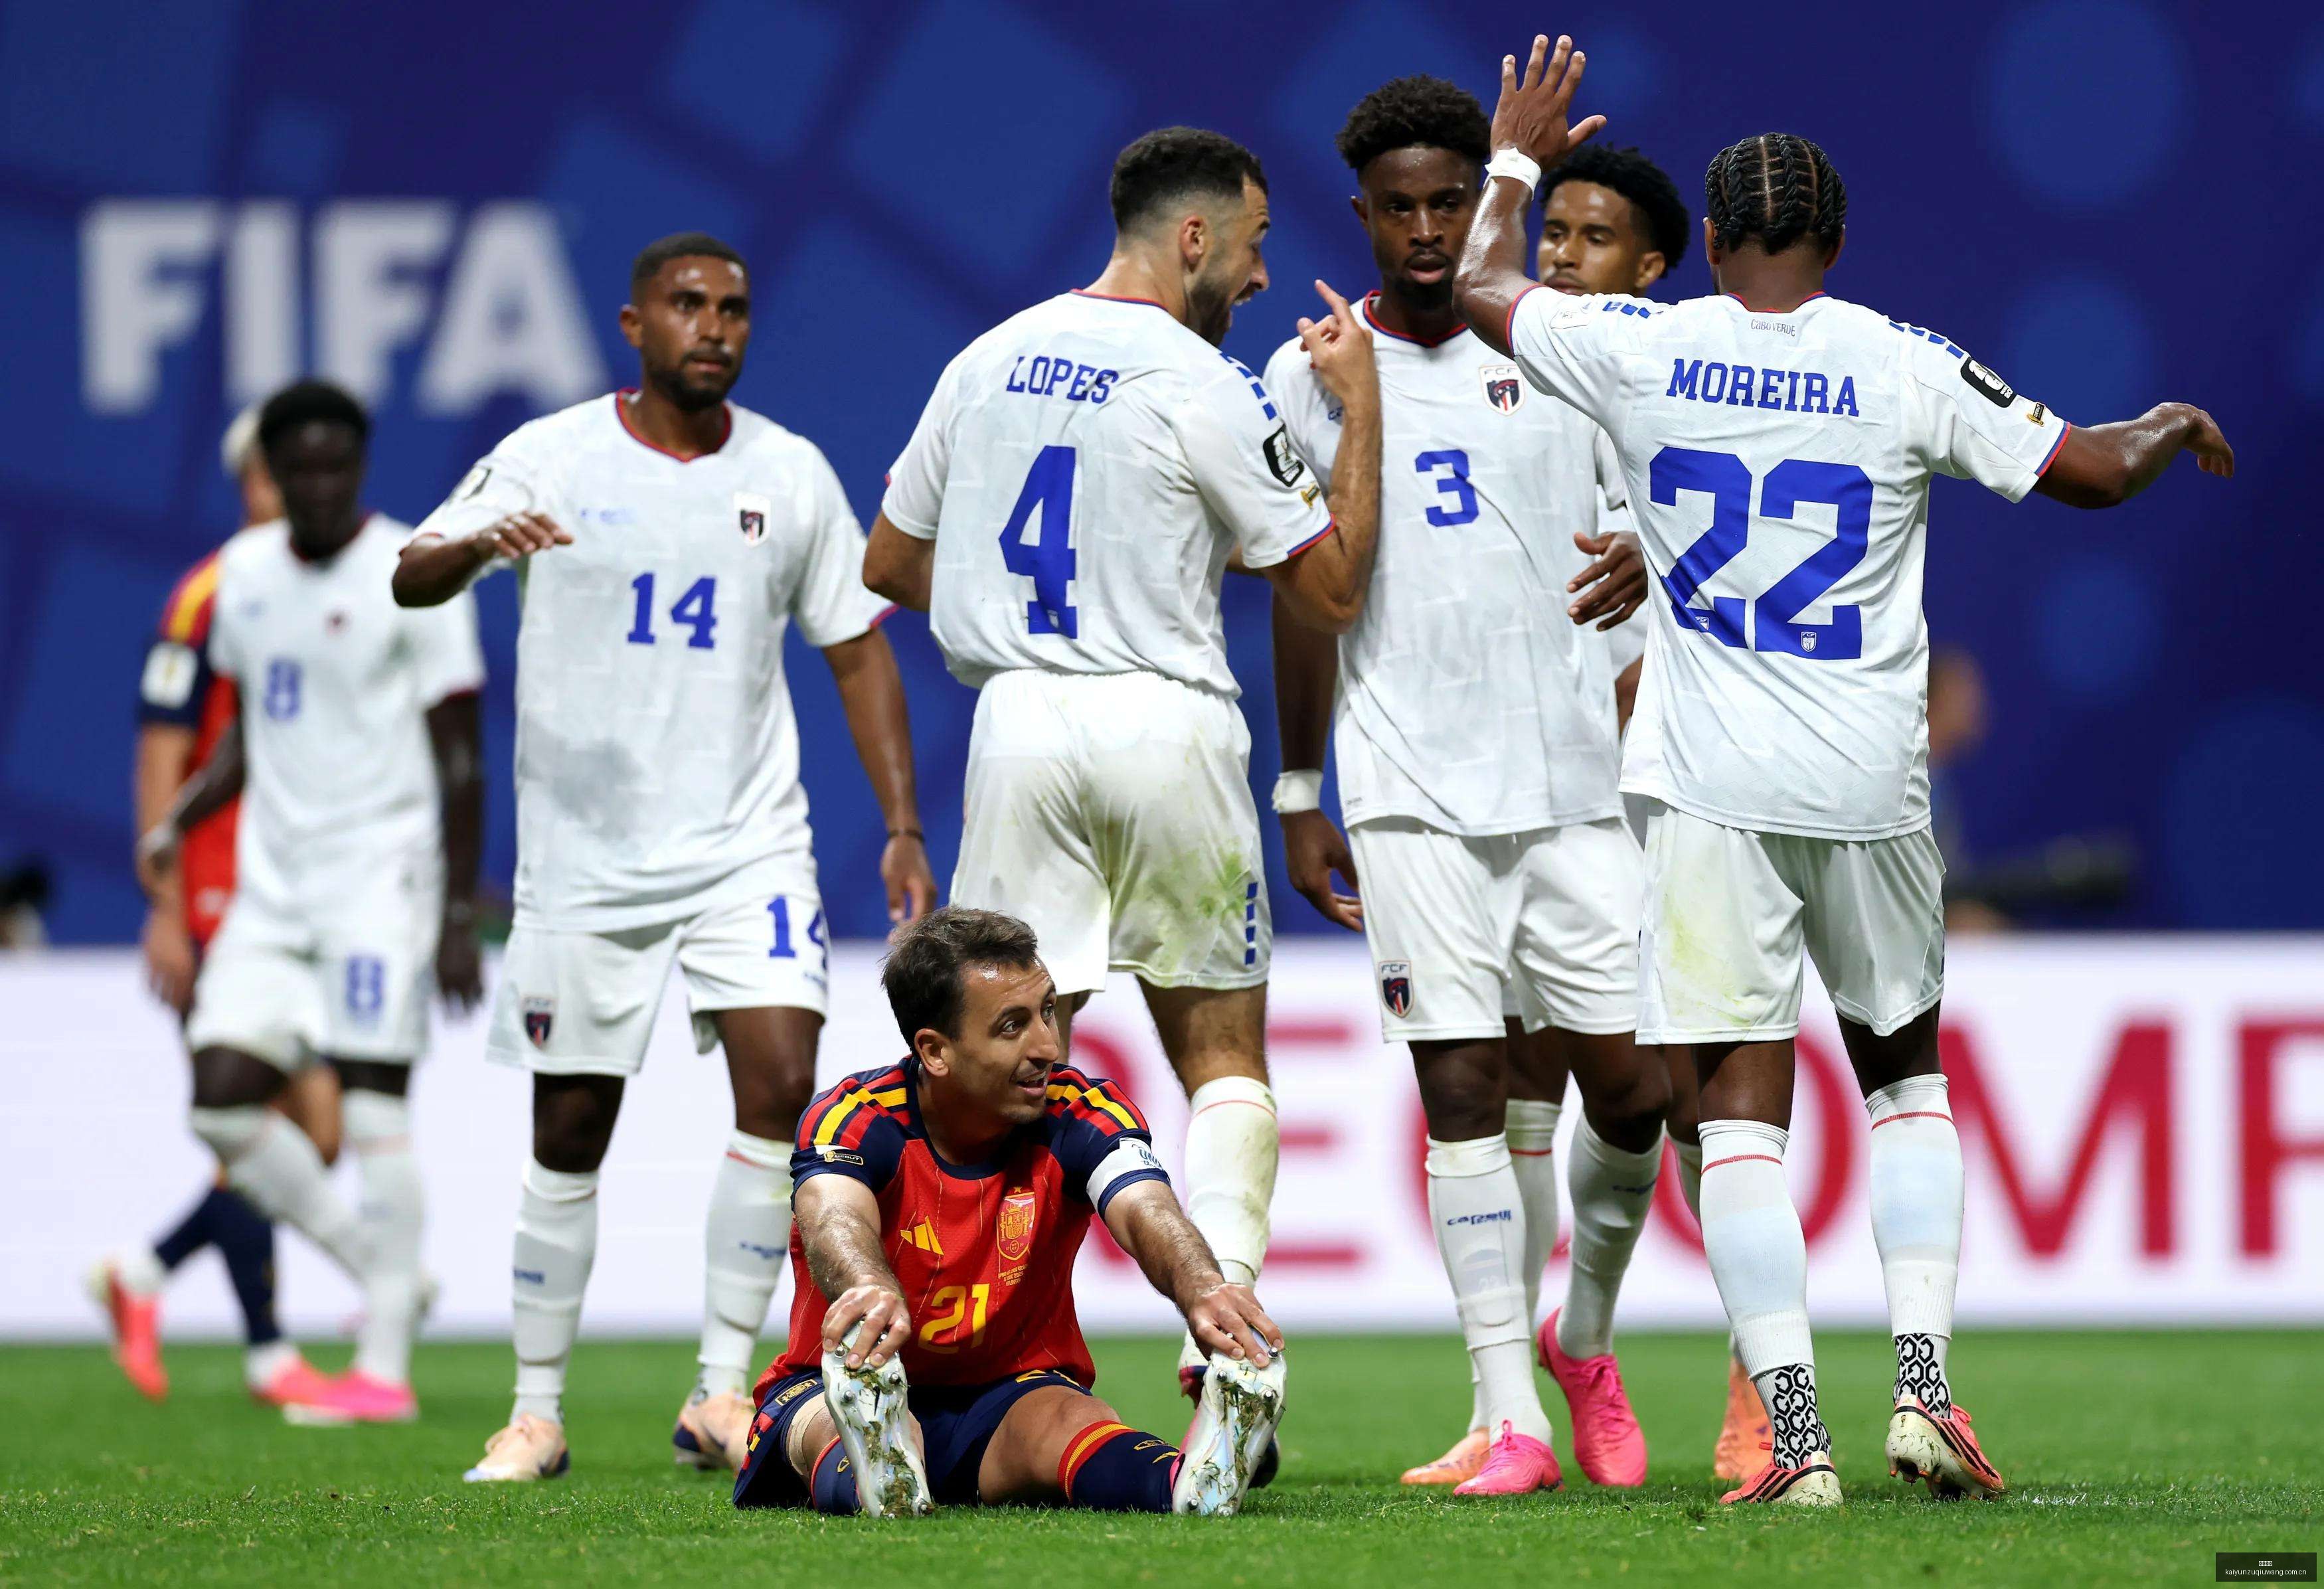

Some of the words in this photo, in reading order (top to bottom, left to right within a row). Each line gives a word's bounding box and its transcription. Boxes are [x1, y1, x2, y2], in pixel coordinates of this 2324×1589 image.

[81, 199, 603, 414] FIFA
[1006, 355, 1119, 404] LOPES
[1666, 357, 1860, 417] MOREIRA
[1415, 450, 1479, 527] 3
[999, 444, 1078, 639] 4
[1649, 446, 1874, 660] 22
[627, 572, 718, 649] 14
[266, 658, 301, 721] 8
[347, 956, 384, 1021] 8
[918, 1283, 990, 1354] 21
